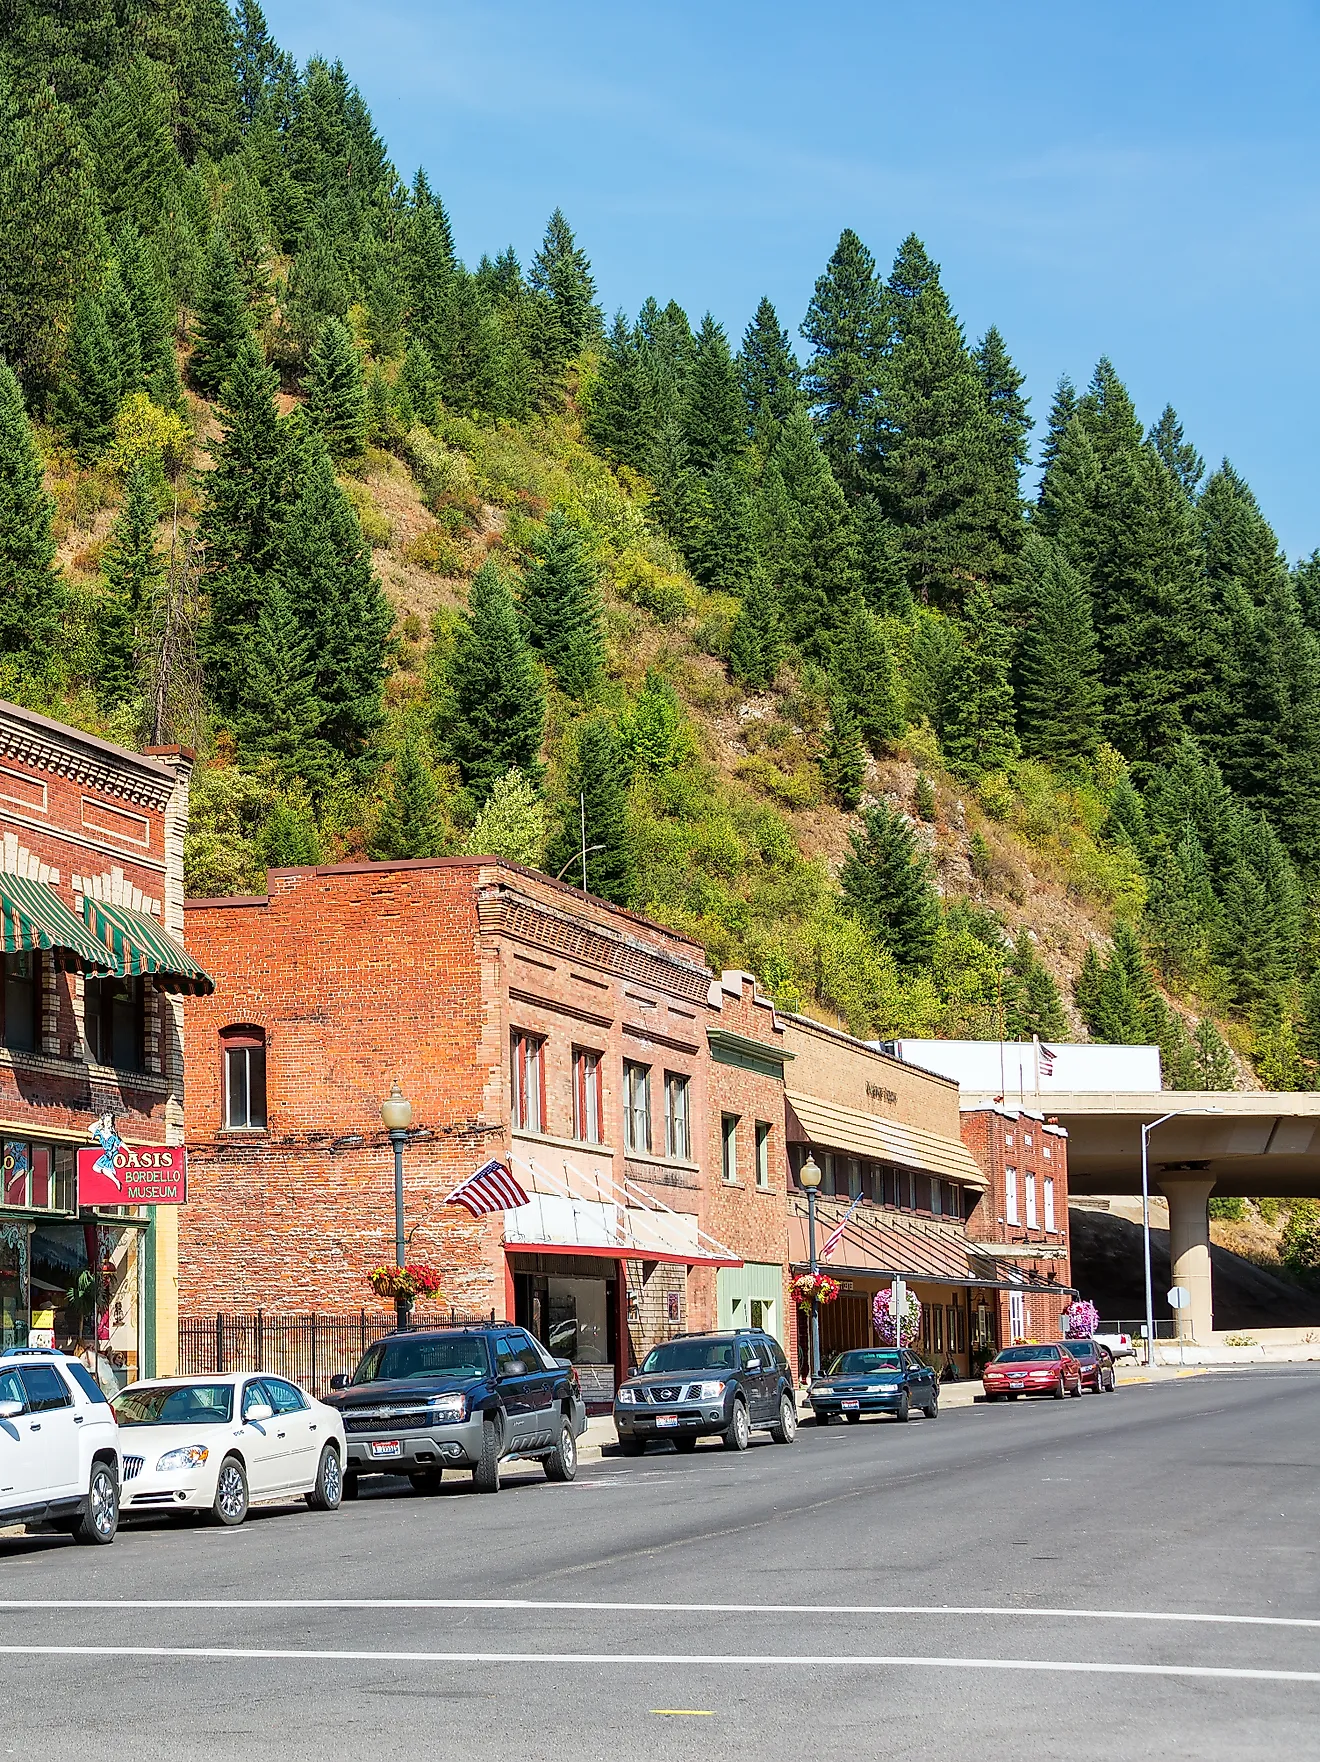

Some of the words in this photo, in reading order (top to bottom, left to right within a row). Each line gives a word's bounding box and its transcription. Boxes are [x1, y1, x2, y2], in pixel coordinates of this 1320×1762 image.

[113, 1151, 174, 1169] OASIS
[125, 1170, 181, 1184] BORDELLO
[128, 1186, 177, 1198] MUSEUM
